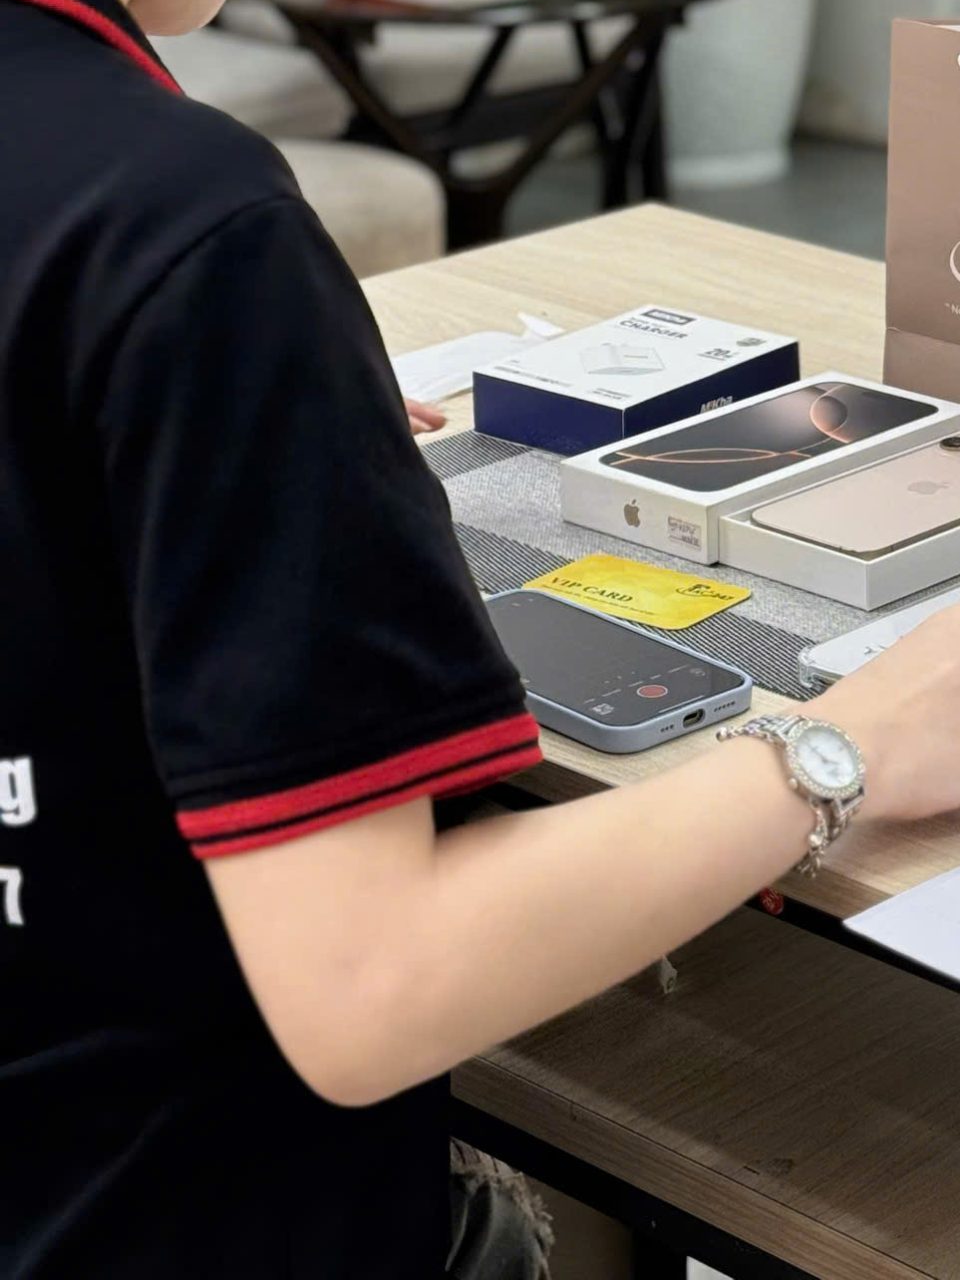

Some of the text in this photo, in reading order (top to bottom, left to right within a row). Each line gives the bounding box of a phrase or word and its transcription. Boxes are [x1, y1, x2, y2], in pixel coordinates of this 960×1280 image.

[619, 320, 688, 339] CHARGER
[551, 577, 582, 590] VIP
[583, 584, 633, 603] CARD
